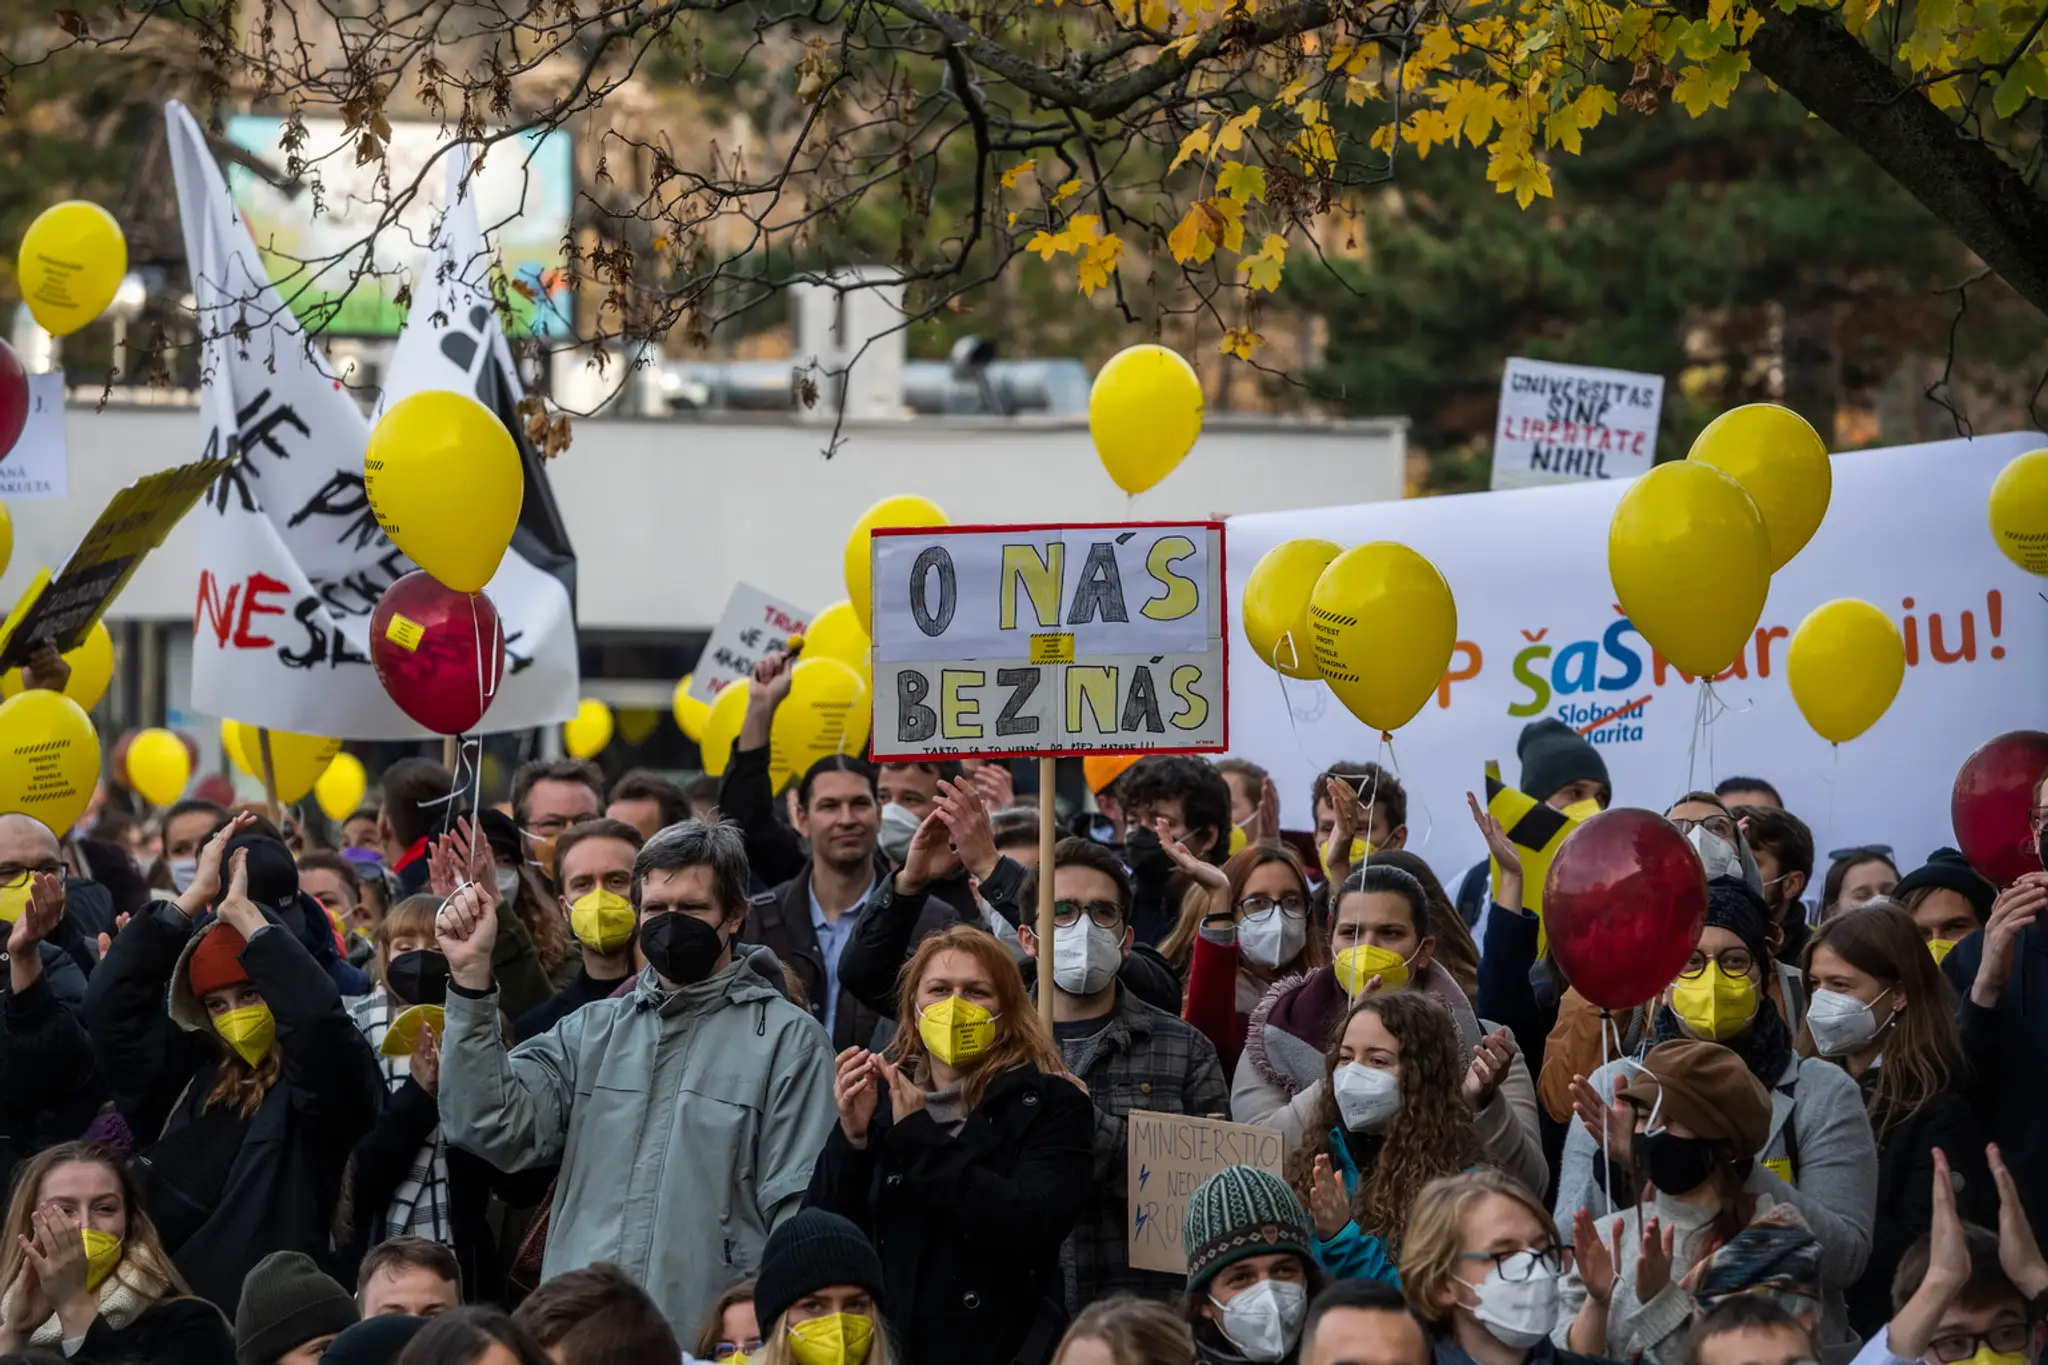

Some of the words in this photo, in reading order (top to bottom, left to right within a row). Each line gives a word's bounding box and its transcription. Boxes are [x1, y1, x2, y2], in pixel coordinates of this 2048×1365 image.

[1511, 373, 1654, 408] UNIVERSITAS
[1546, 394, 1612, 428] SINE
[1504, 416, 1647, 456] LIBERTATE
[1530, 442, 1611, 480] NIHIL
[909, 545, 957, 637] O
[1000, 532, 1199, 630] NÁS
[897, 668, 1041, 743] BEZ
[1065, 656, 1209, 733] NÁS
[988, 745, 1001, 754] TO
[1134, 1121, 1279, 1168] MINISTERSTVO
